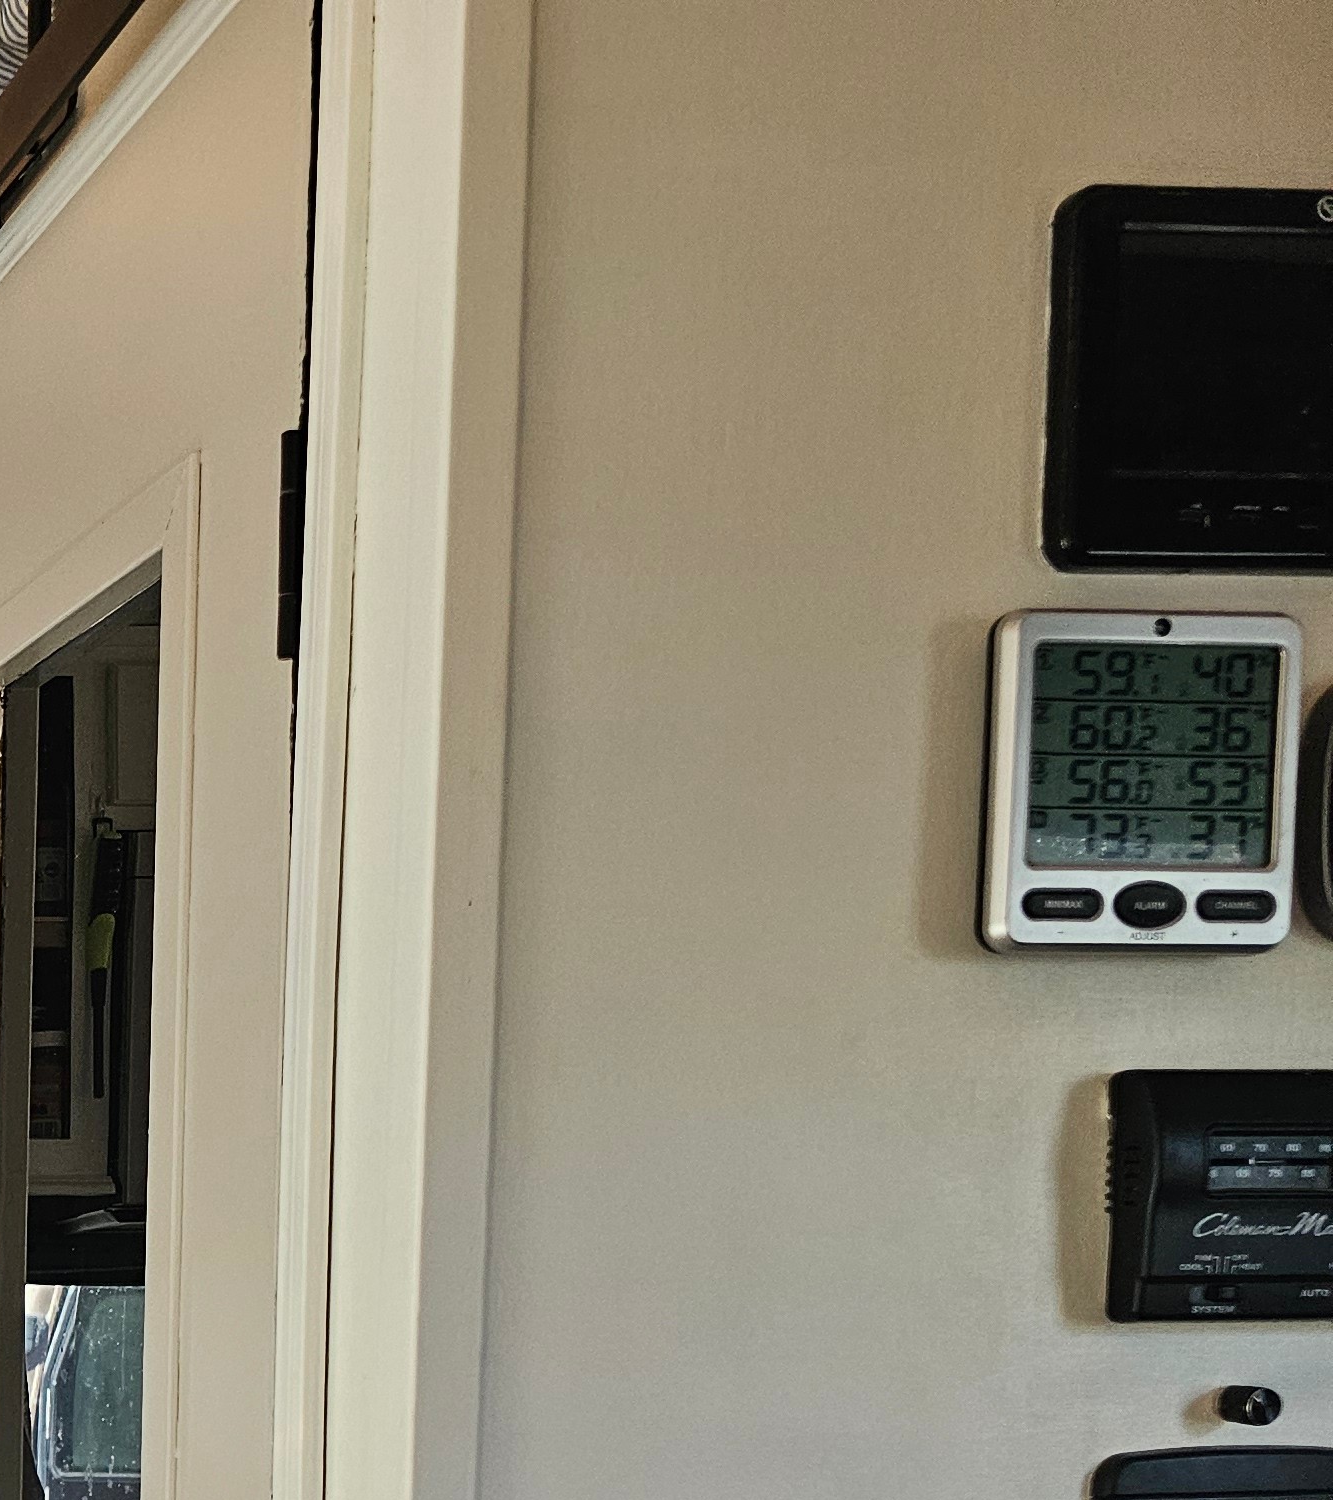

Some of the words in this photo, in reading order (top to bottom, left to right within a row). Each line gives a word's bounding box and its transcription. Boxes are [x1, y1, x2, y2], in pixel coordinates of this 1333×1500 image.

[1193, 652, 1254, 698] 40
[1190, 707, 1251, 751] 36
[1187, 761, 1250, 806] 53
[1186, 814, 1249, 860] 37
[1134, 901, 1166, 910] ALARM
[1214, 901, 1259, 910] CHANNEL
[1129, 932, 1165, 940] ADJUST
[1179, 1263, 1203, 1271] COOL
[1300, 1288, 1331, 1297] AUTO
[1191, 1305, 1235, 1314] SYSTEM
